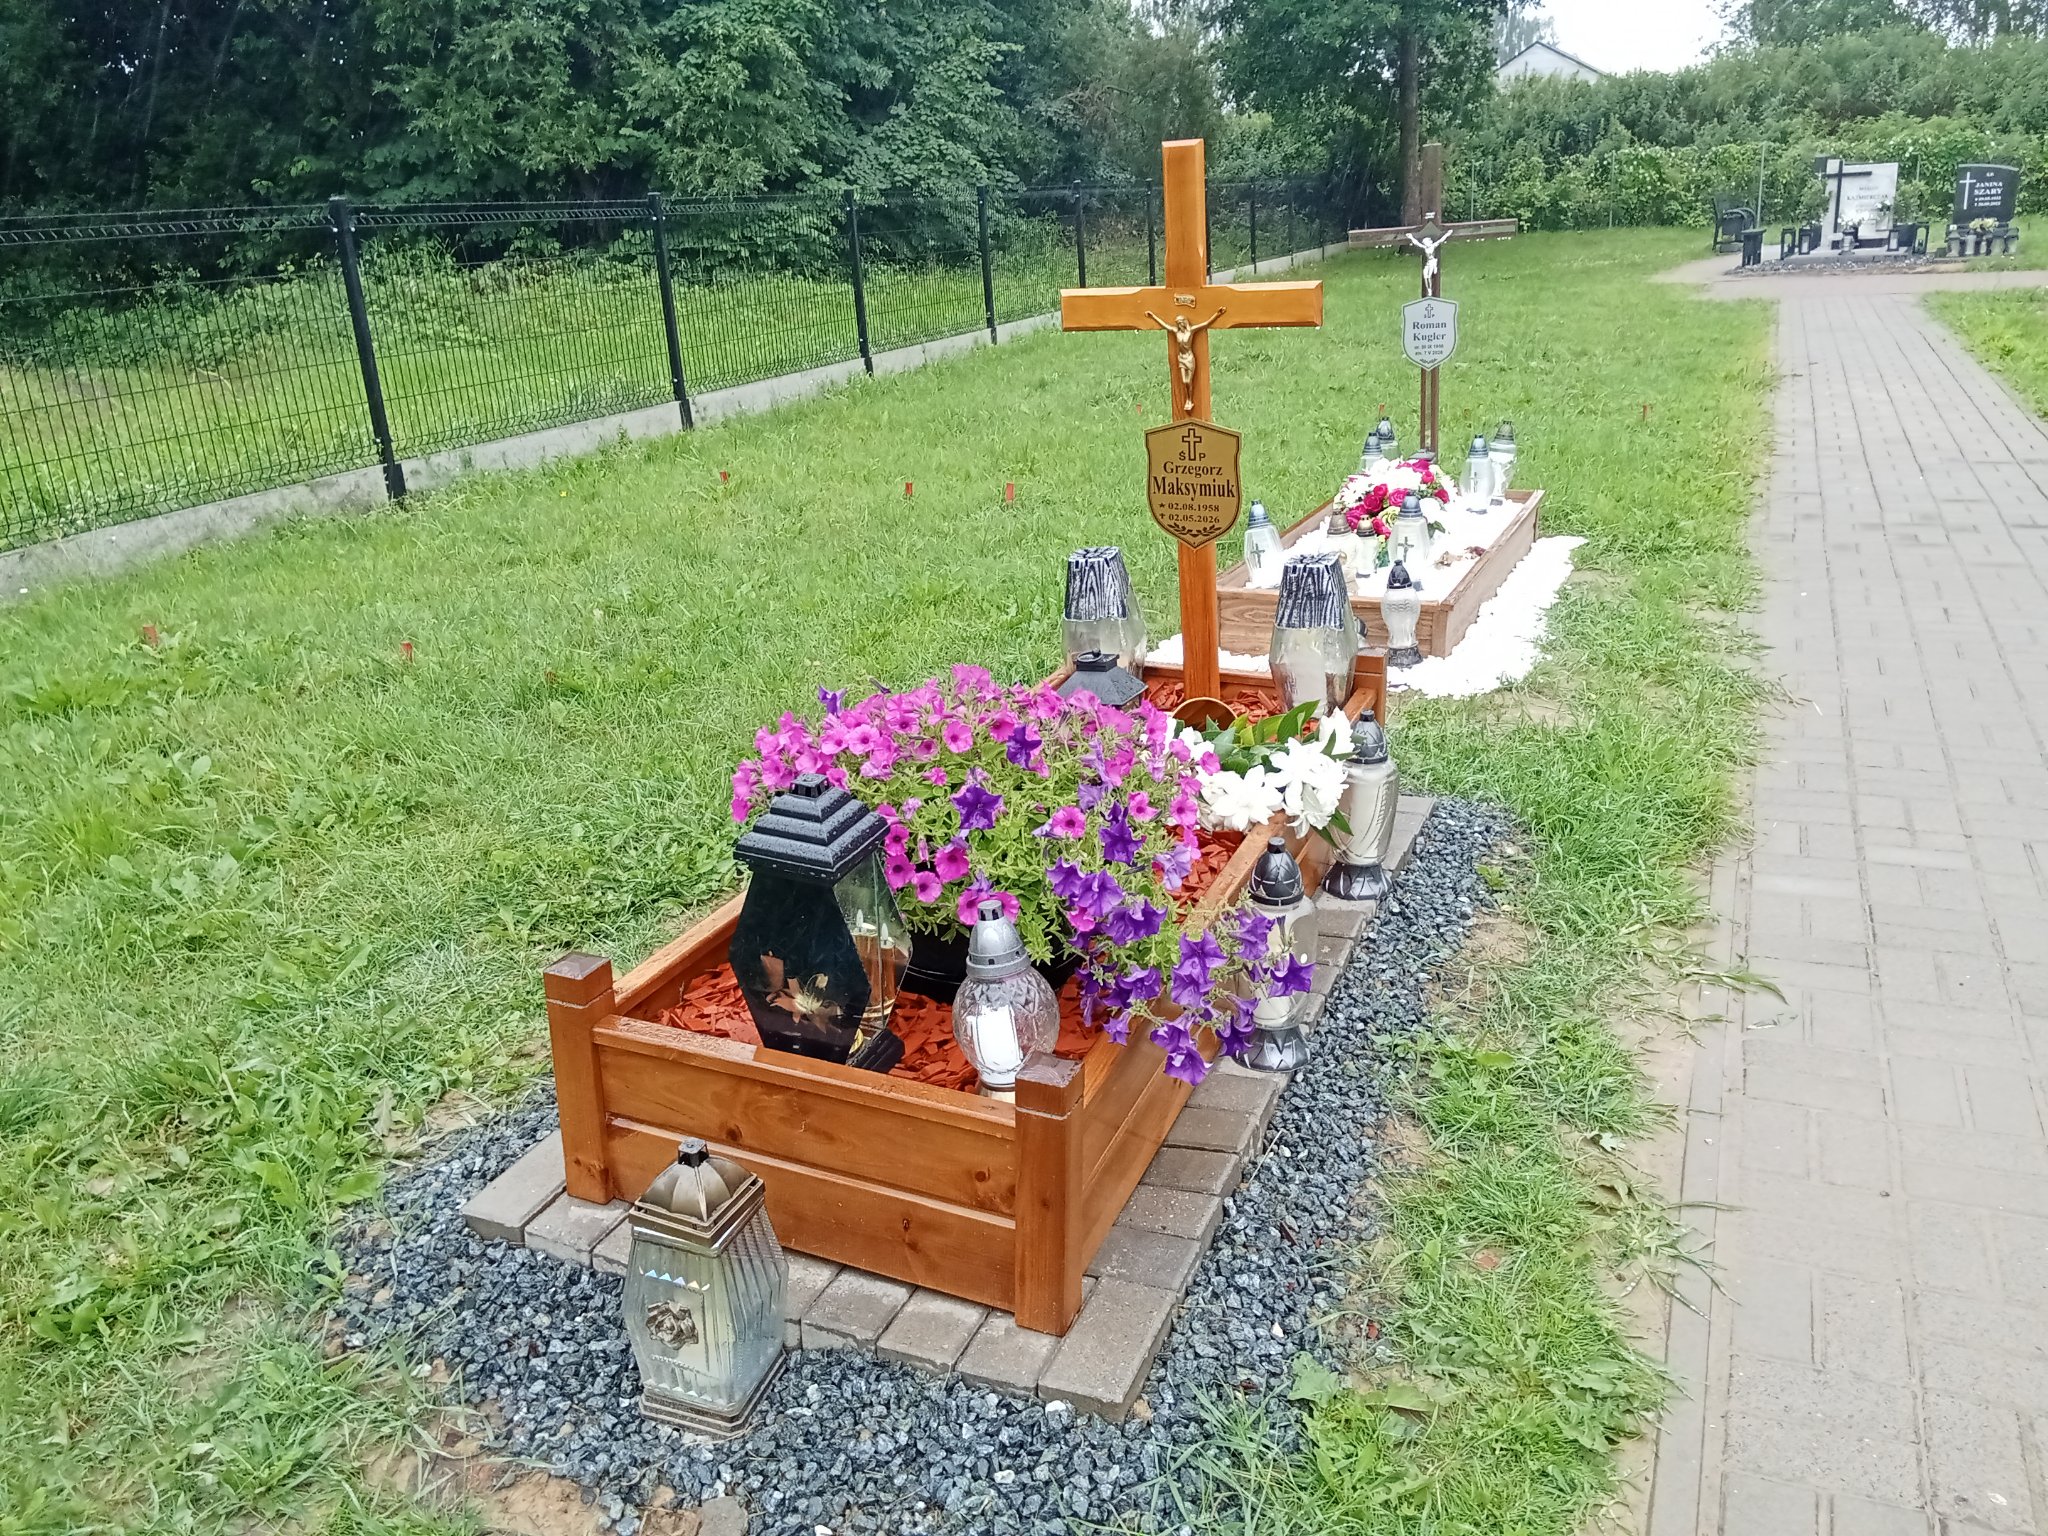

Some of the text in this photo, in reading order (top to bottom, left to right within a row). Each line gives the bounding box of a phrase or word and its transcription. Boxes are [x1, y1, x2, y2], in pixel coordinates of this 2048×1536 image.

[1412, 321, 1447, 329] Roman
[1413, 332, 1447, 342] Kugler
[1178, 450, 1206, 461] Ś P
[1163, 461, 1223, 478] Grzegorz
[1152, 476, 1236, 501] Maksymiuk
[1168, 502, 1220, 512] 02.08.1958
[1168, 513, 1220, 524] 02.05.2026
